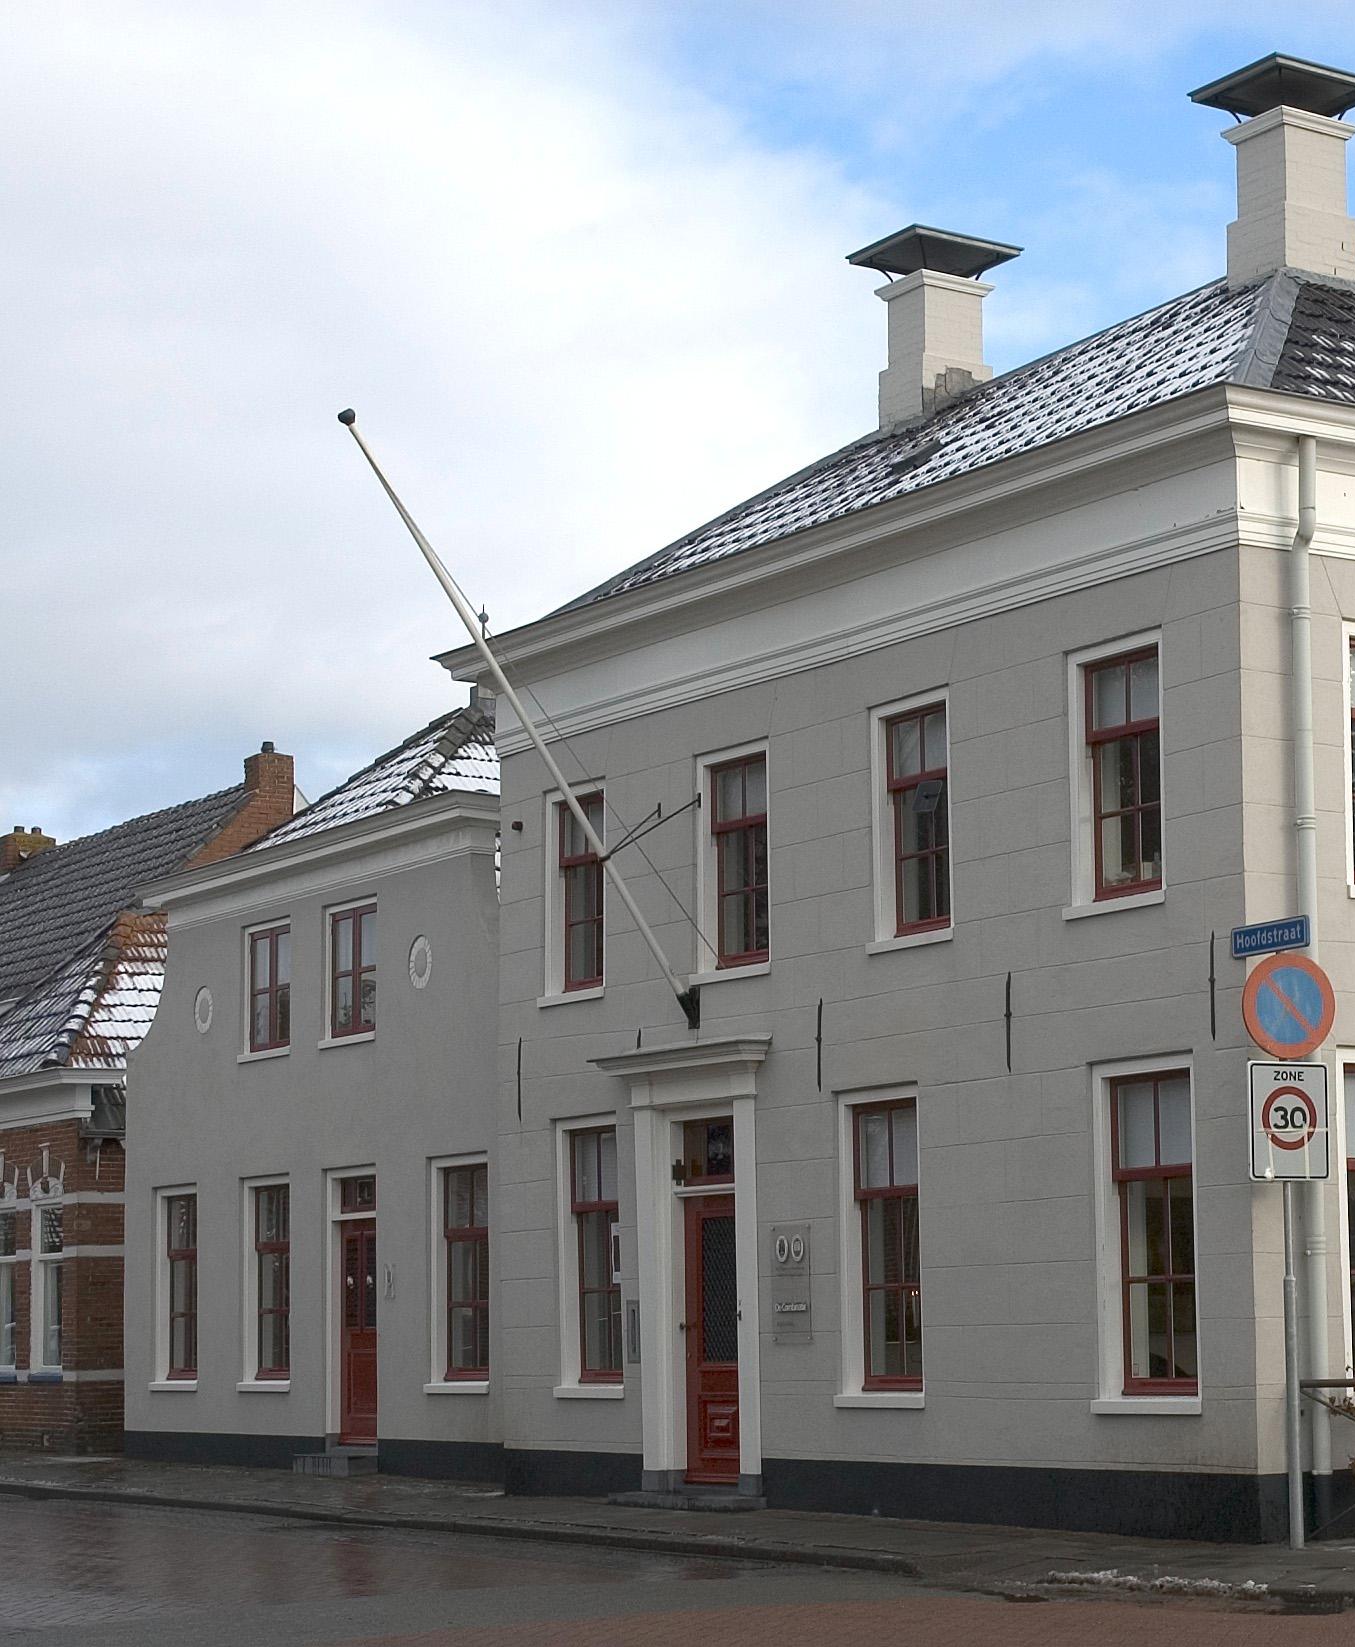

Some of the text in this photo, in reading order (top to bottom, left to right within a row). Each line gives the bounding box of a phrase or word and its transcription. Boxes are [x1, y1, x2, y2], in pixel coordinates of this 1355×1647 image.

[1236, 923, 1301, 949] Hoofdstraat
[1273, 1070, 1305, 1081] ZONE
[1272, 1105, 1307, 1130] 30
